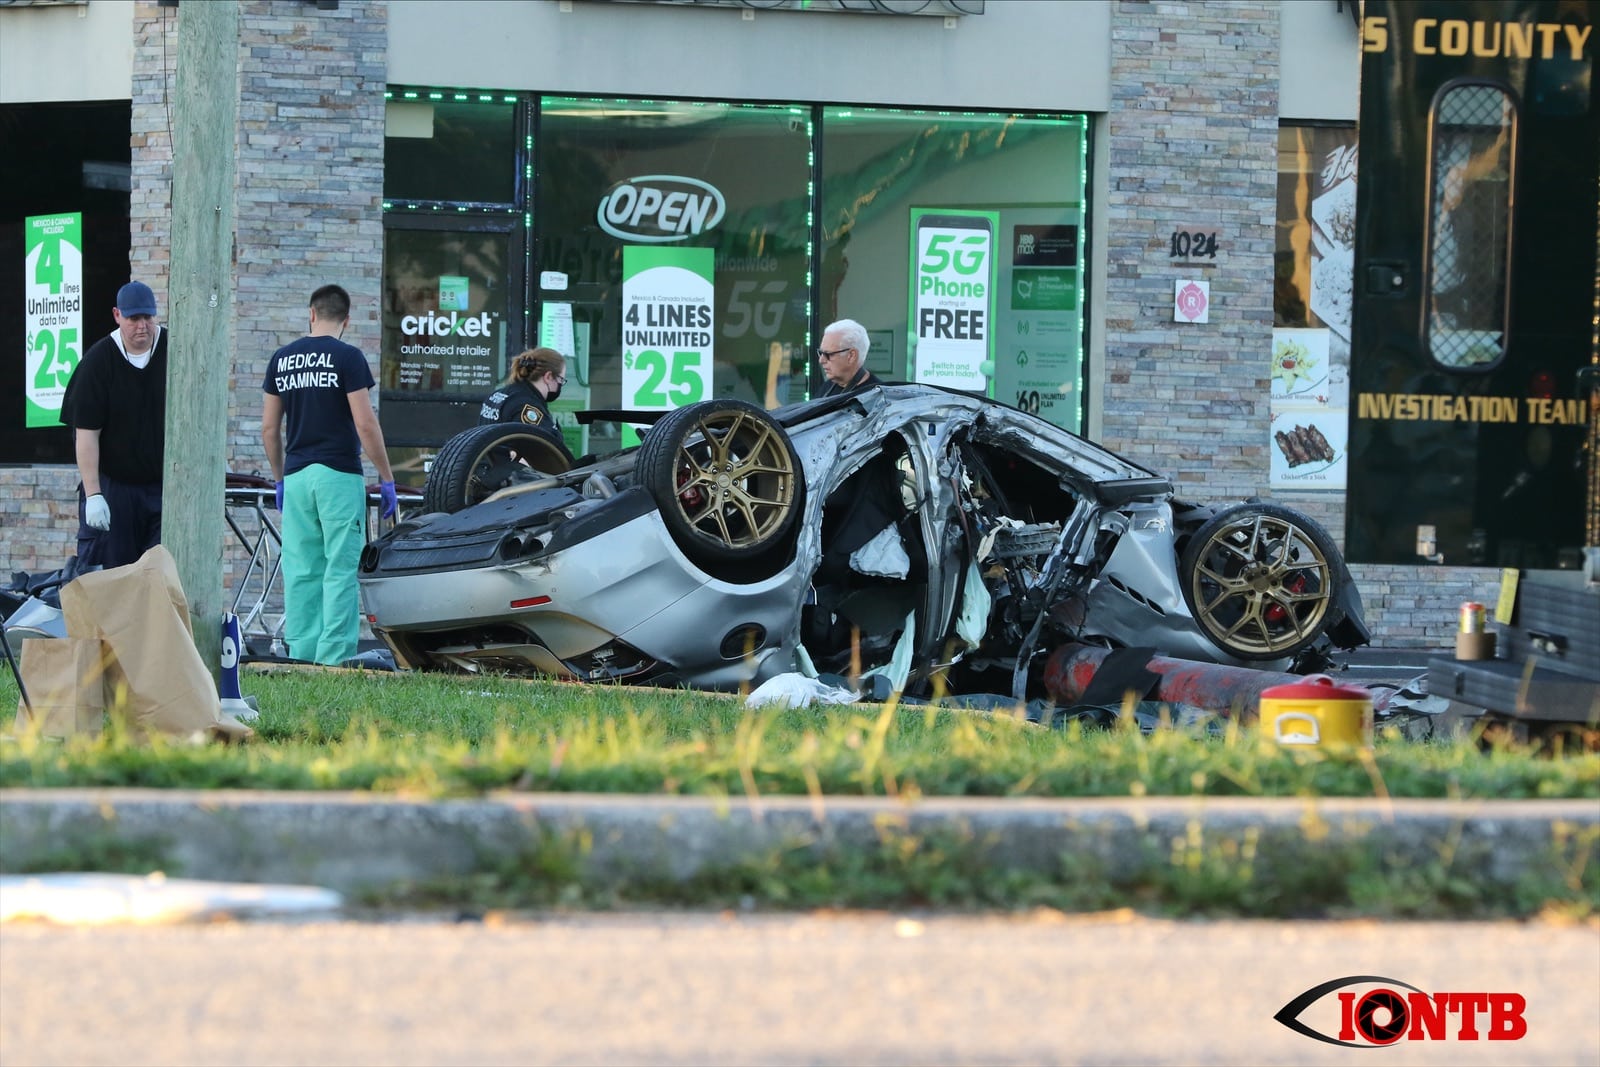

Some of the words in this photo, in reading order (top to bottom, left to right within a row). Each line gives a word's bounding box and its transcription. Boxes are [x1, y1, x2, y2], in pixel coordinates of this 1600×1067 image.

[1413, 19, 1593, 60] COUNTY
[606, 184, 713, 235] OPEN
[920, 234, 987, 275] 5G
[1169, 231, 1219, 259] 1024
[35, 238, 63, 294] 4
[64, 283, 79, 294] lines
[920, 276, 985, 298] Phone
[28, 295, 80, 315] Unlimited
[722, 281, 788, 339] 5G
[1188, 297, 1196, 307] R
[39, 316, 57, 326] data
[58, 315, 68, 325] for
[401, 310, 492, 337] cricket
[625, 303, 640, 327] 4
[647, 303, 711, 329] LINES
[920, 308, 984, 340] FREE
[400, 344, 454, 355] authorized
[456, 345, 491, 356] retailer
[625, 330, 711, 348] UNLIMITED
[27, 327, 79, 389] $25
[277, 352, 334, 372] MEDICAL
[955, 363, 970, 371] and
[275, 371, 339, 392] EXAMINER
[624, 350, 704, 408] $25
[1041, 393, 1066, 401] UNLIMITED
[1041, 401, 1054, 409] PLAN
[1358, 392, 1518, 423] INVESTIGATION
[1526, 398, 1587, 424] TEAM
